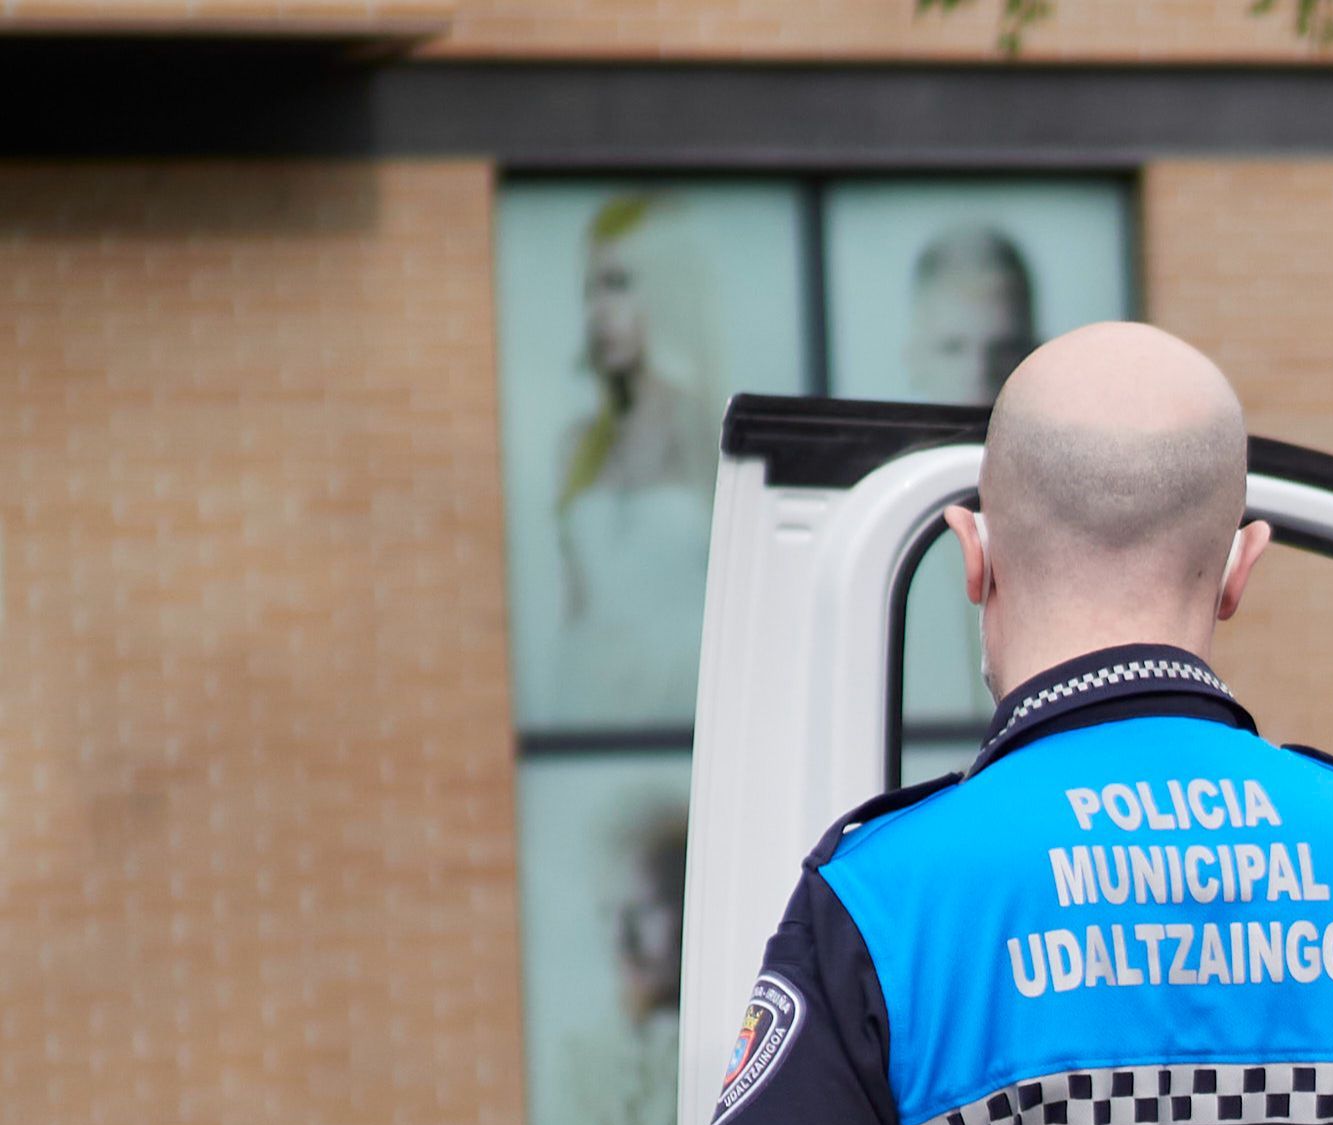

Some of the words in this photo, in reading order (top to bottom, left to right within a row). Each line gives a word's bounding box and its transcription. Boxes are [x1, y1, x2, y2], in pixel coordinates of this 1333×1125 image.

[1066, 778, 1281, 831] POLICIA
[1048, 842, 1330, 907] MUNICIPAL
[724, 1027, 786, 1107] UDALTZAINGOA
